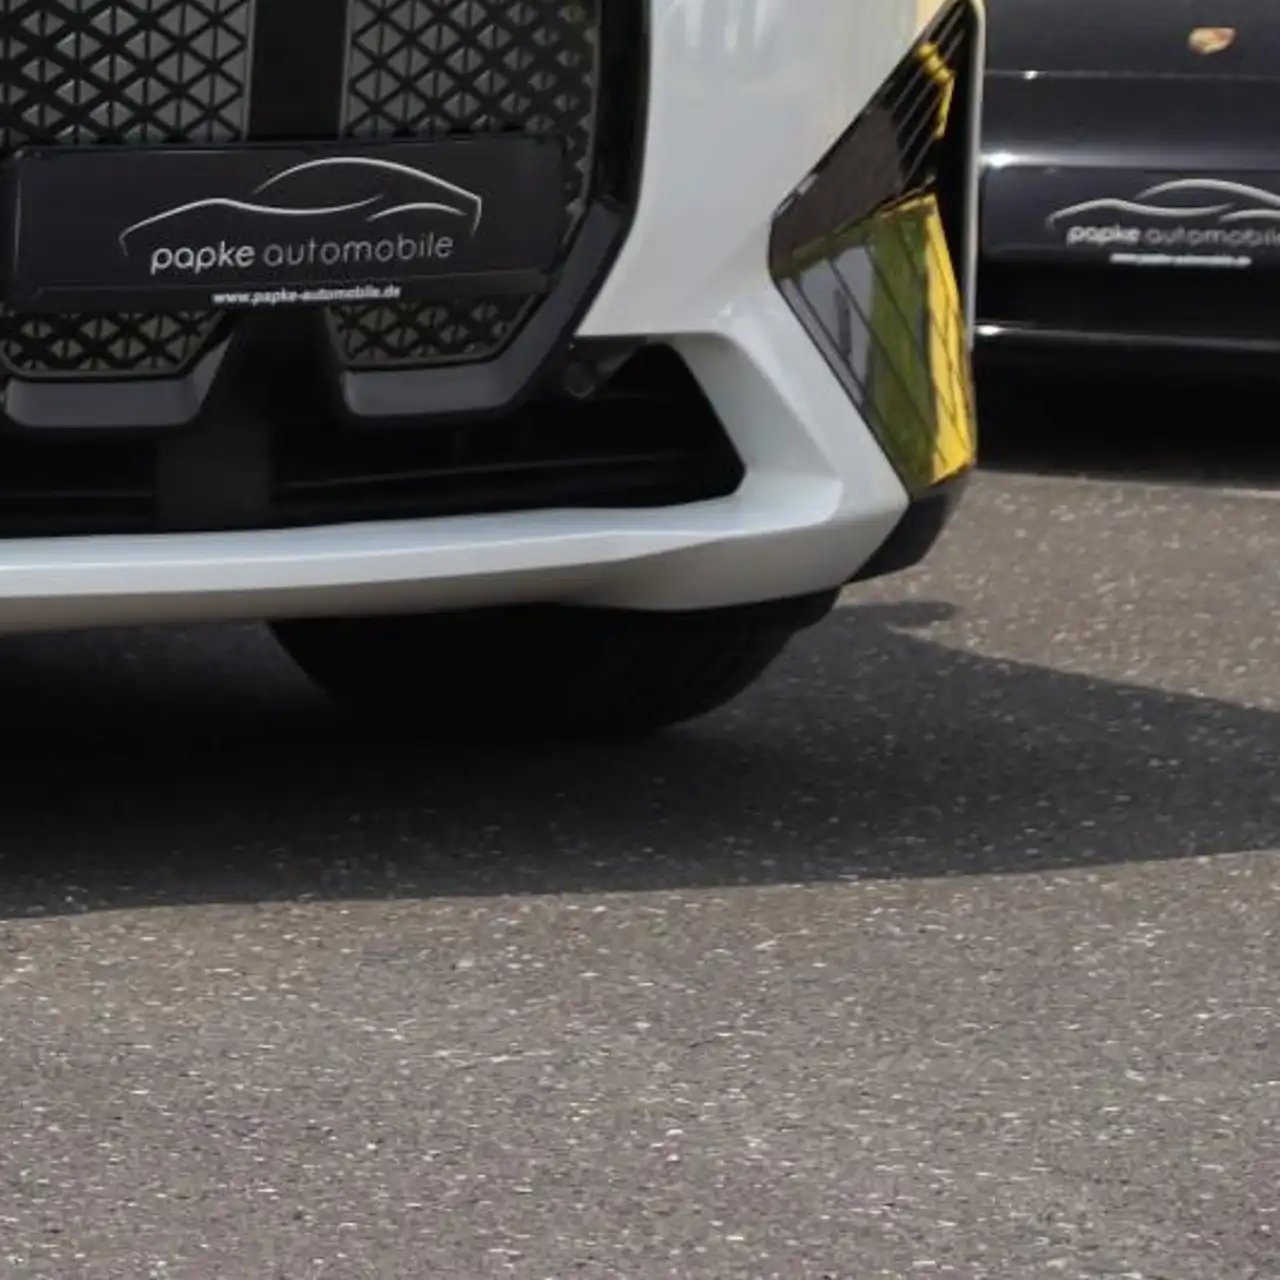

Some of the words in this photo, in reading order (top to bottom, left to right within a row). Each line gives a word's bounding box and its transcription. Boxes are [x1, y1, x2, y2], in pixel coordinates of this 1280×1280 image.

[150, 240, 256, 275] papke
[262, 230, 454, 267] automobile
[211, 284, 402, 306] www.papke-automobile.de
